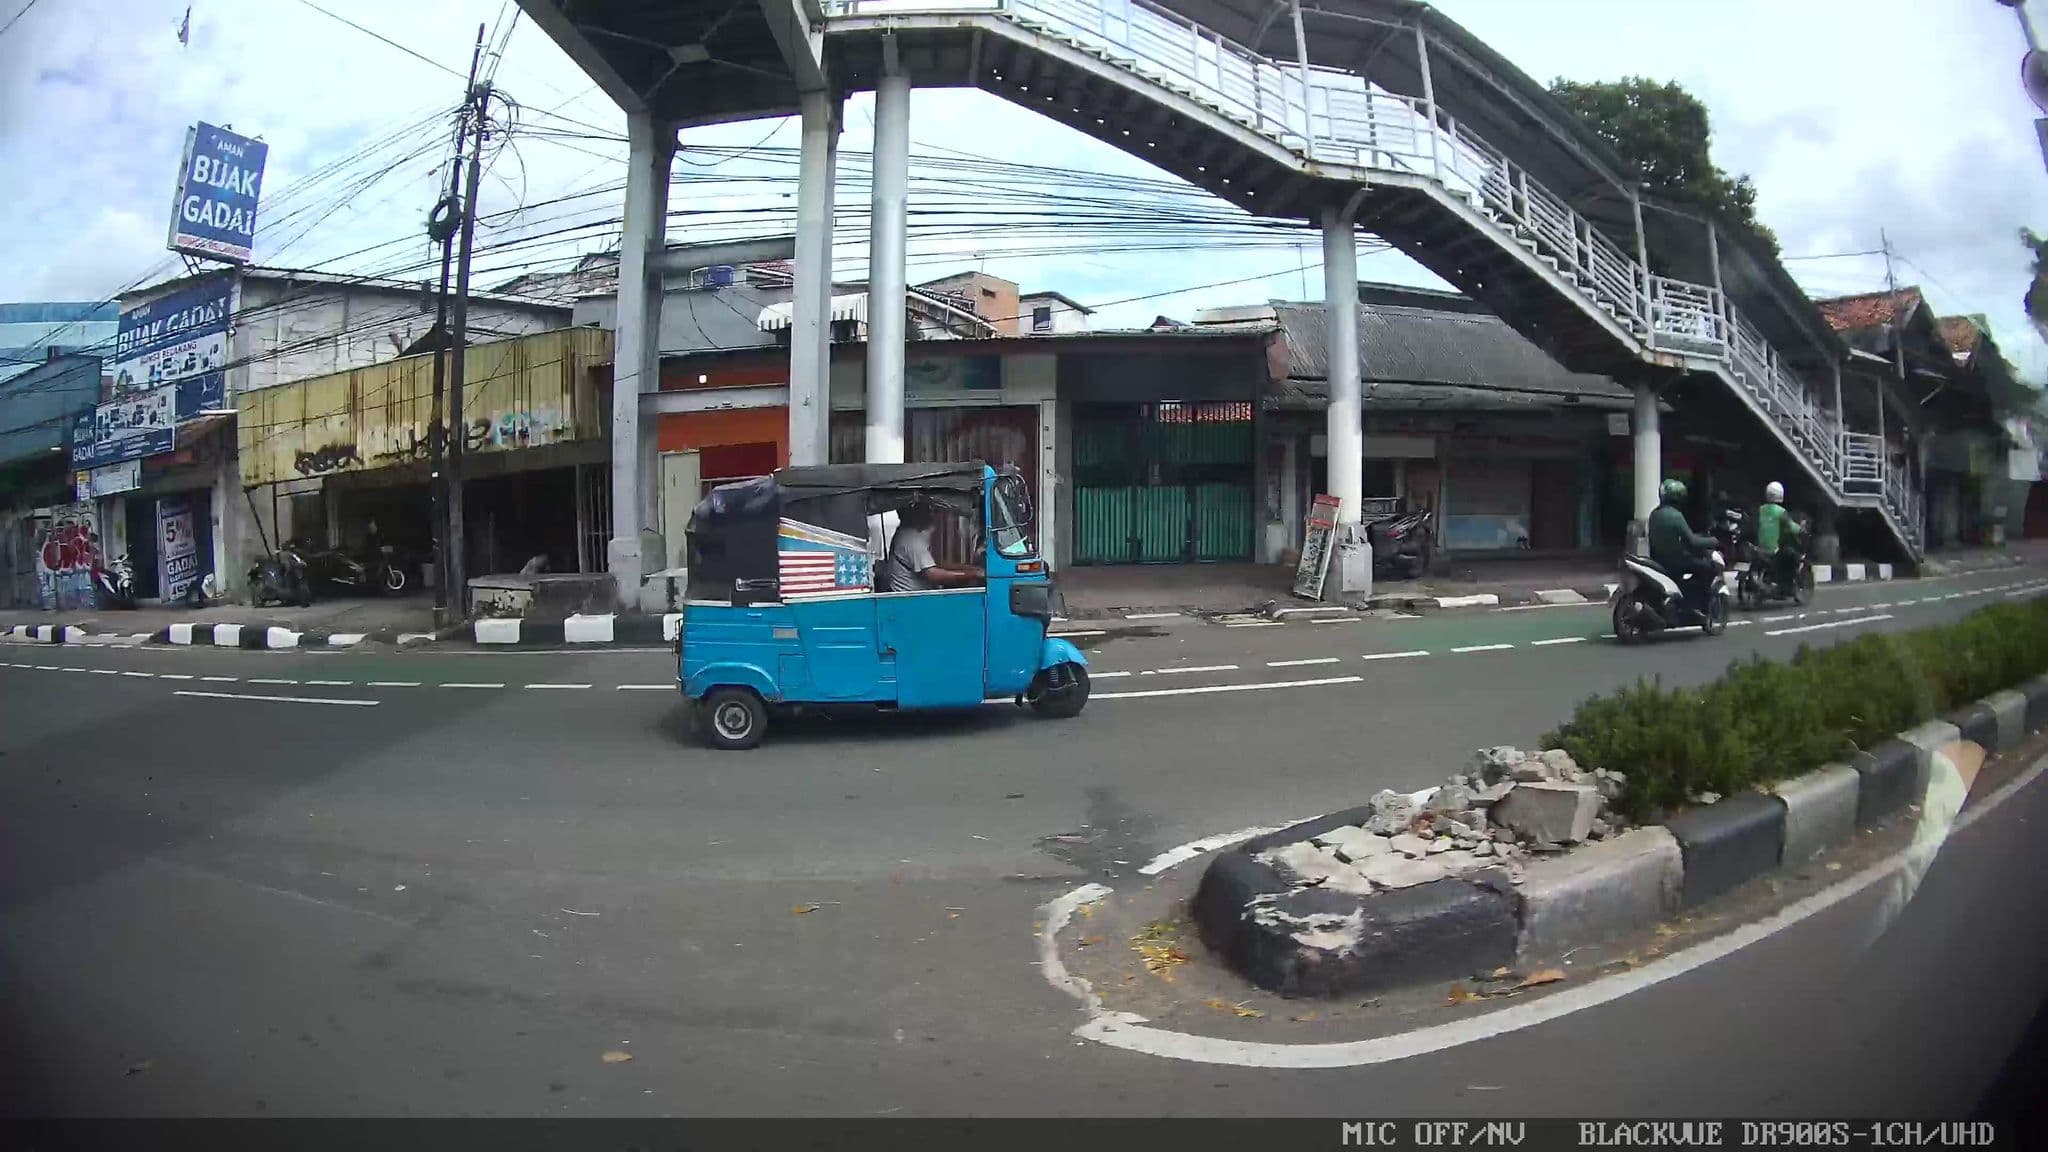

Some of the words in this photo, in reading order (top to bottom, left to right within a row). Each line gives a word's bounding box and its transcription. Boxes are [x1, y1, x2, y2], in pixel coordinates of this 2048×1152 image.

[217, 140, 243, 157] AMAN
[192, 154, 258, 198] BIJAK
[183, 194, 254, 236] GADAI
[118, 319, 162, 354] BIJAK
[166, 296, 226, 332] GADAI
[73, 443, 95, 462] GADAI
